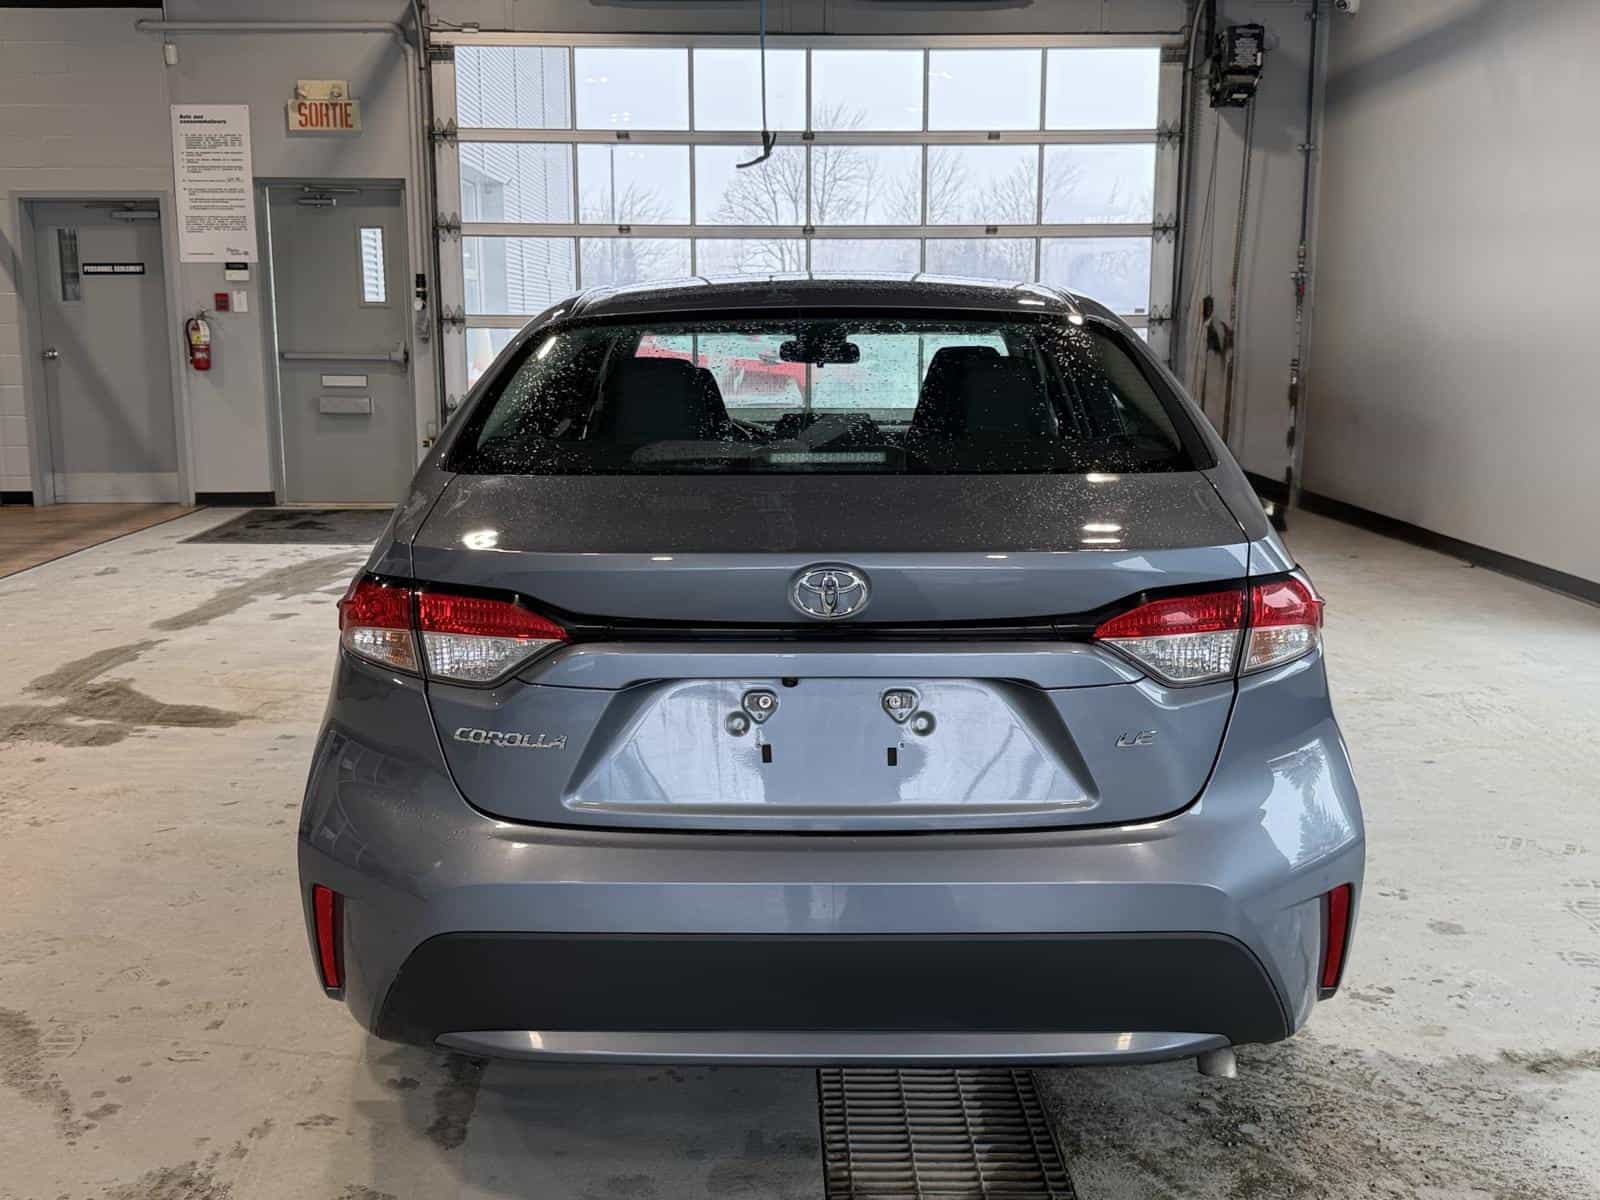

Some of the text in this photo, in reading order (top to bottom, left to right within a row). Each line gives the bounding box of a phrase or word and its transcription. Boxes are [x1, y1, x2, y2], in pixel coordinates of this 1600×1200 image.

[298, 102, 353, 128] SORTIE
[453, 727, 568, 752] COROLLA
[1115, 729, 1157, 749] LE
